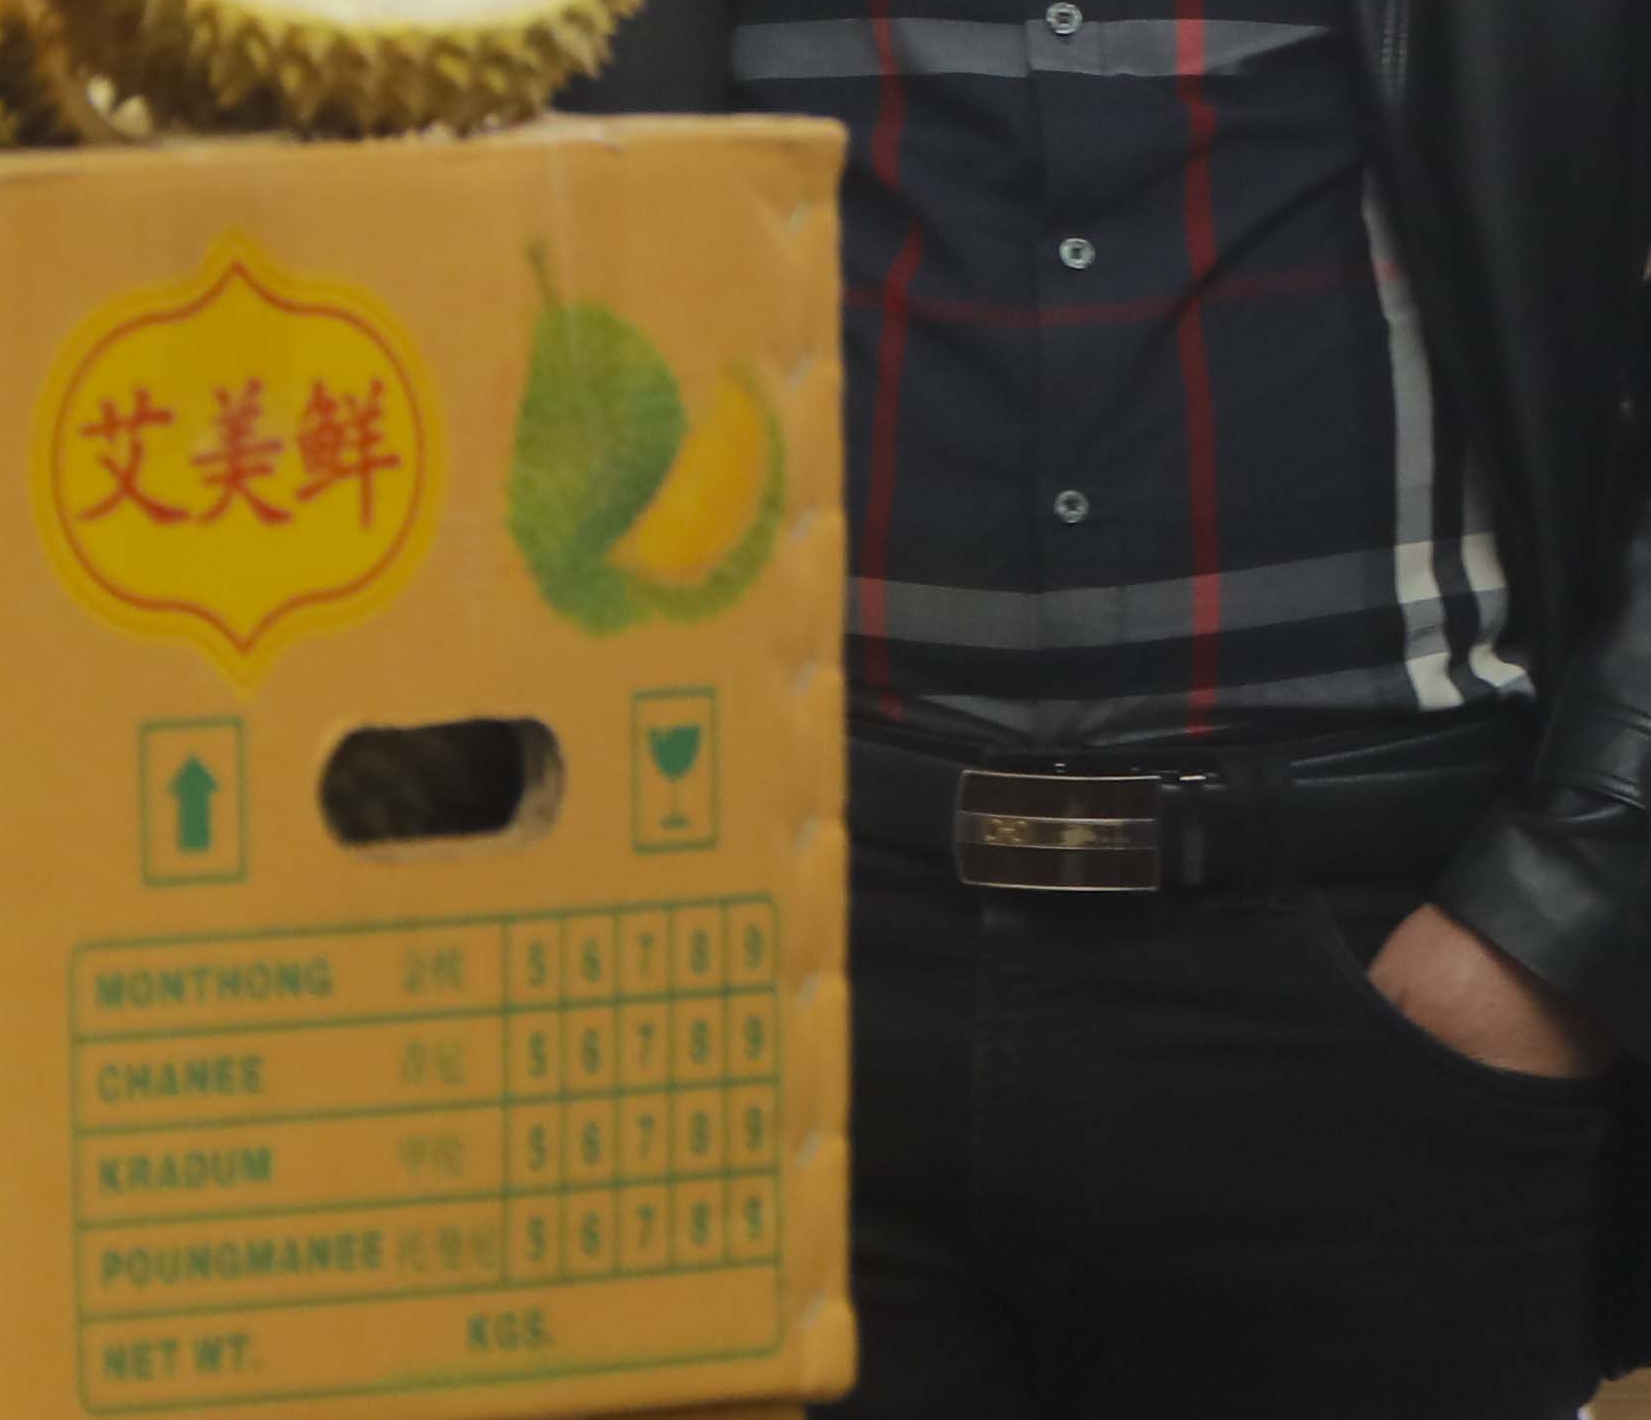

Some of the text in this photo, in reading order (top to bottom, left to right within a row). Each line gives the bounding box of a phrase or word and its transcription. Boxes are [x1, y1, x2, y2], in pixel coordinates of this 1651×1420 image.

[79, 376, 401, 533] 艾美鲜
[96, 957, 334, 1009] MONTHONG
[527, 941, 546, 987] 5
[582, 938, 600, 983] 6
[636, 932, 654, 976] 7
[690, 928, 709, 975] 8
[744, 924, 764, 969] 9
[97, 1014, 764, 1103] CHANEE 5 6 7 8 9
[99, 1106, 764, 1195] KRADUM 5 6 7 8 9
[101, 1229, 382, 1288] POUNGMANEE
[527, 1215, 546, 1261] 5
[581, 1211, 600, 1256] 6
[636, 1204, 655, 1251] 7
[690, 1201, 710, 1247] 8
[744, 1196, 763, 1241] 9
[103, 1338, 179, 1381] NET
